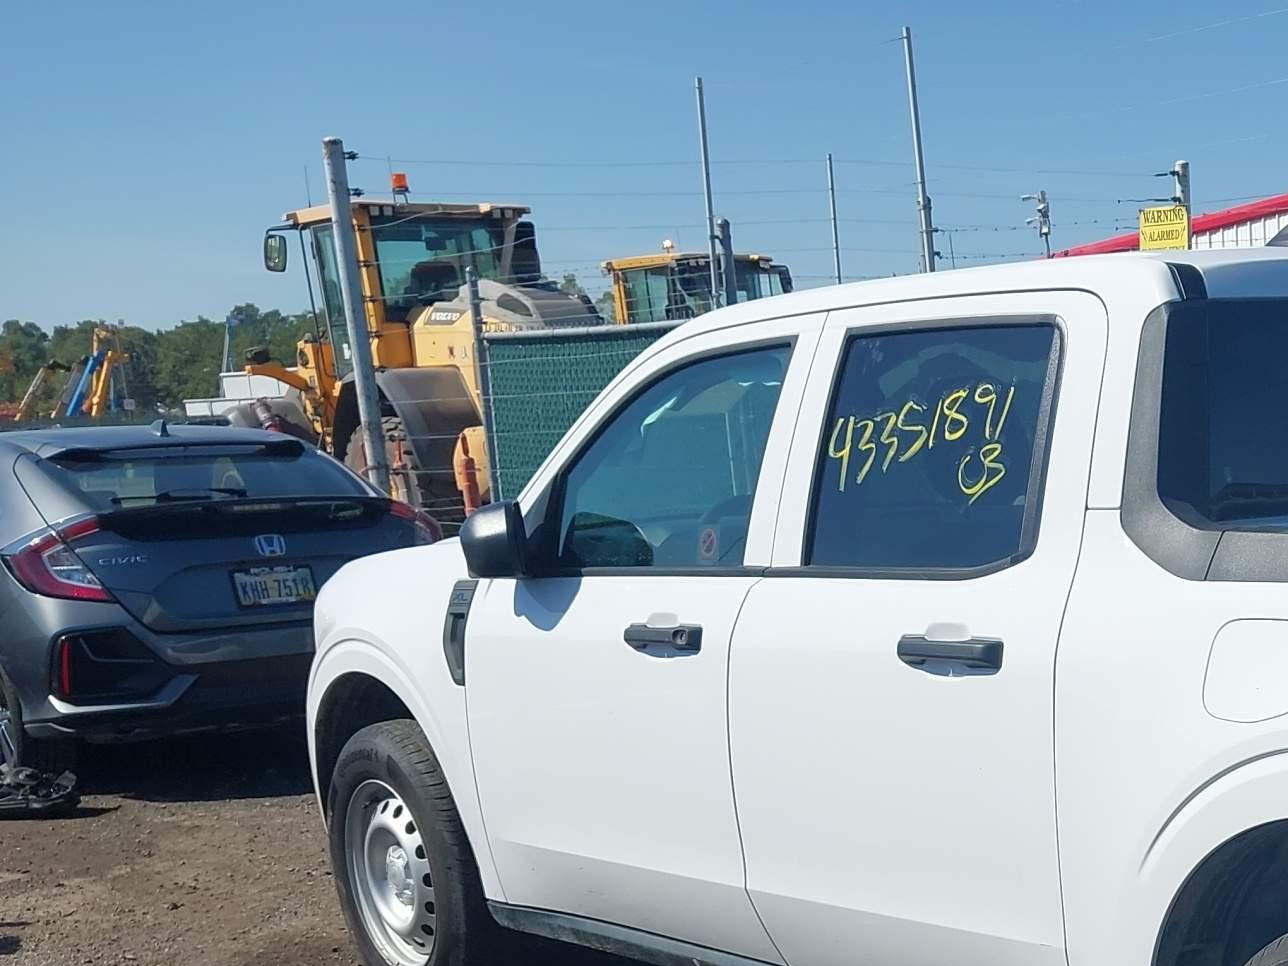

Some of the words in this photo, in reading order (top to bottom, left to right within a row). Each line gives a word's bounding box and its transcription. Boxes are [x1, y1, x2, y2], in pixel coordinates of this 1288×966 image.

[1143, 207, 1185, 224] WARNING
[1148, 229, 1180, 242] ALARMED
[98, 554, 149, 566] CIVIC
